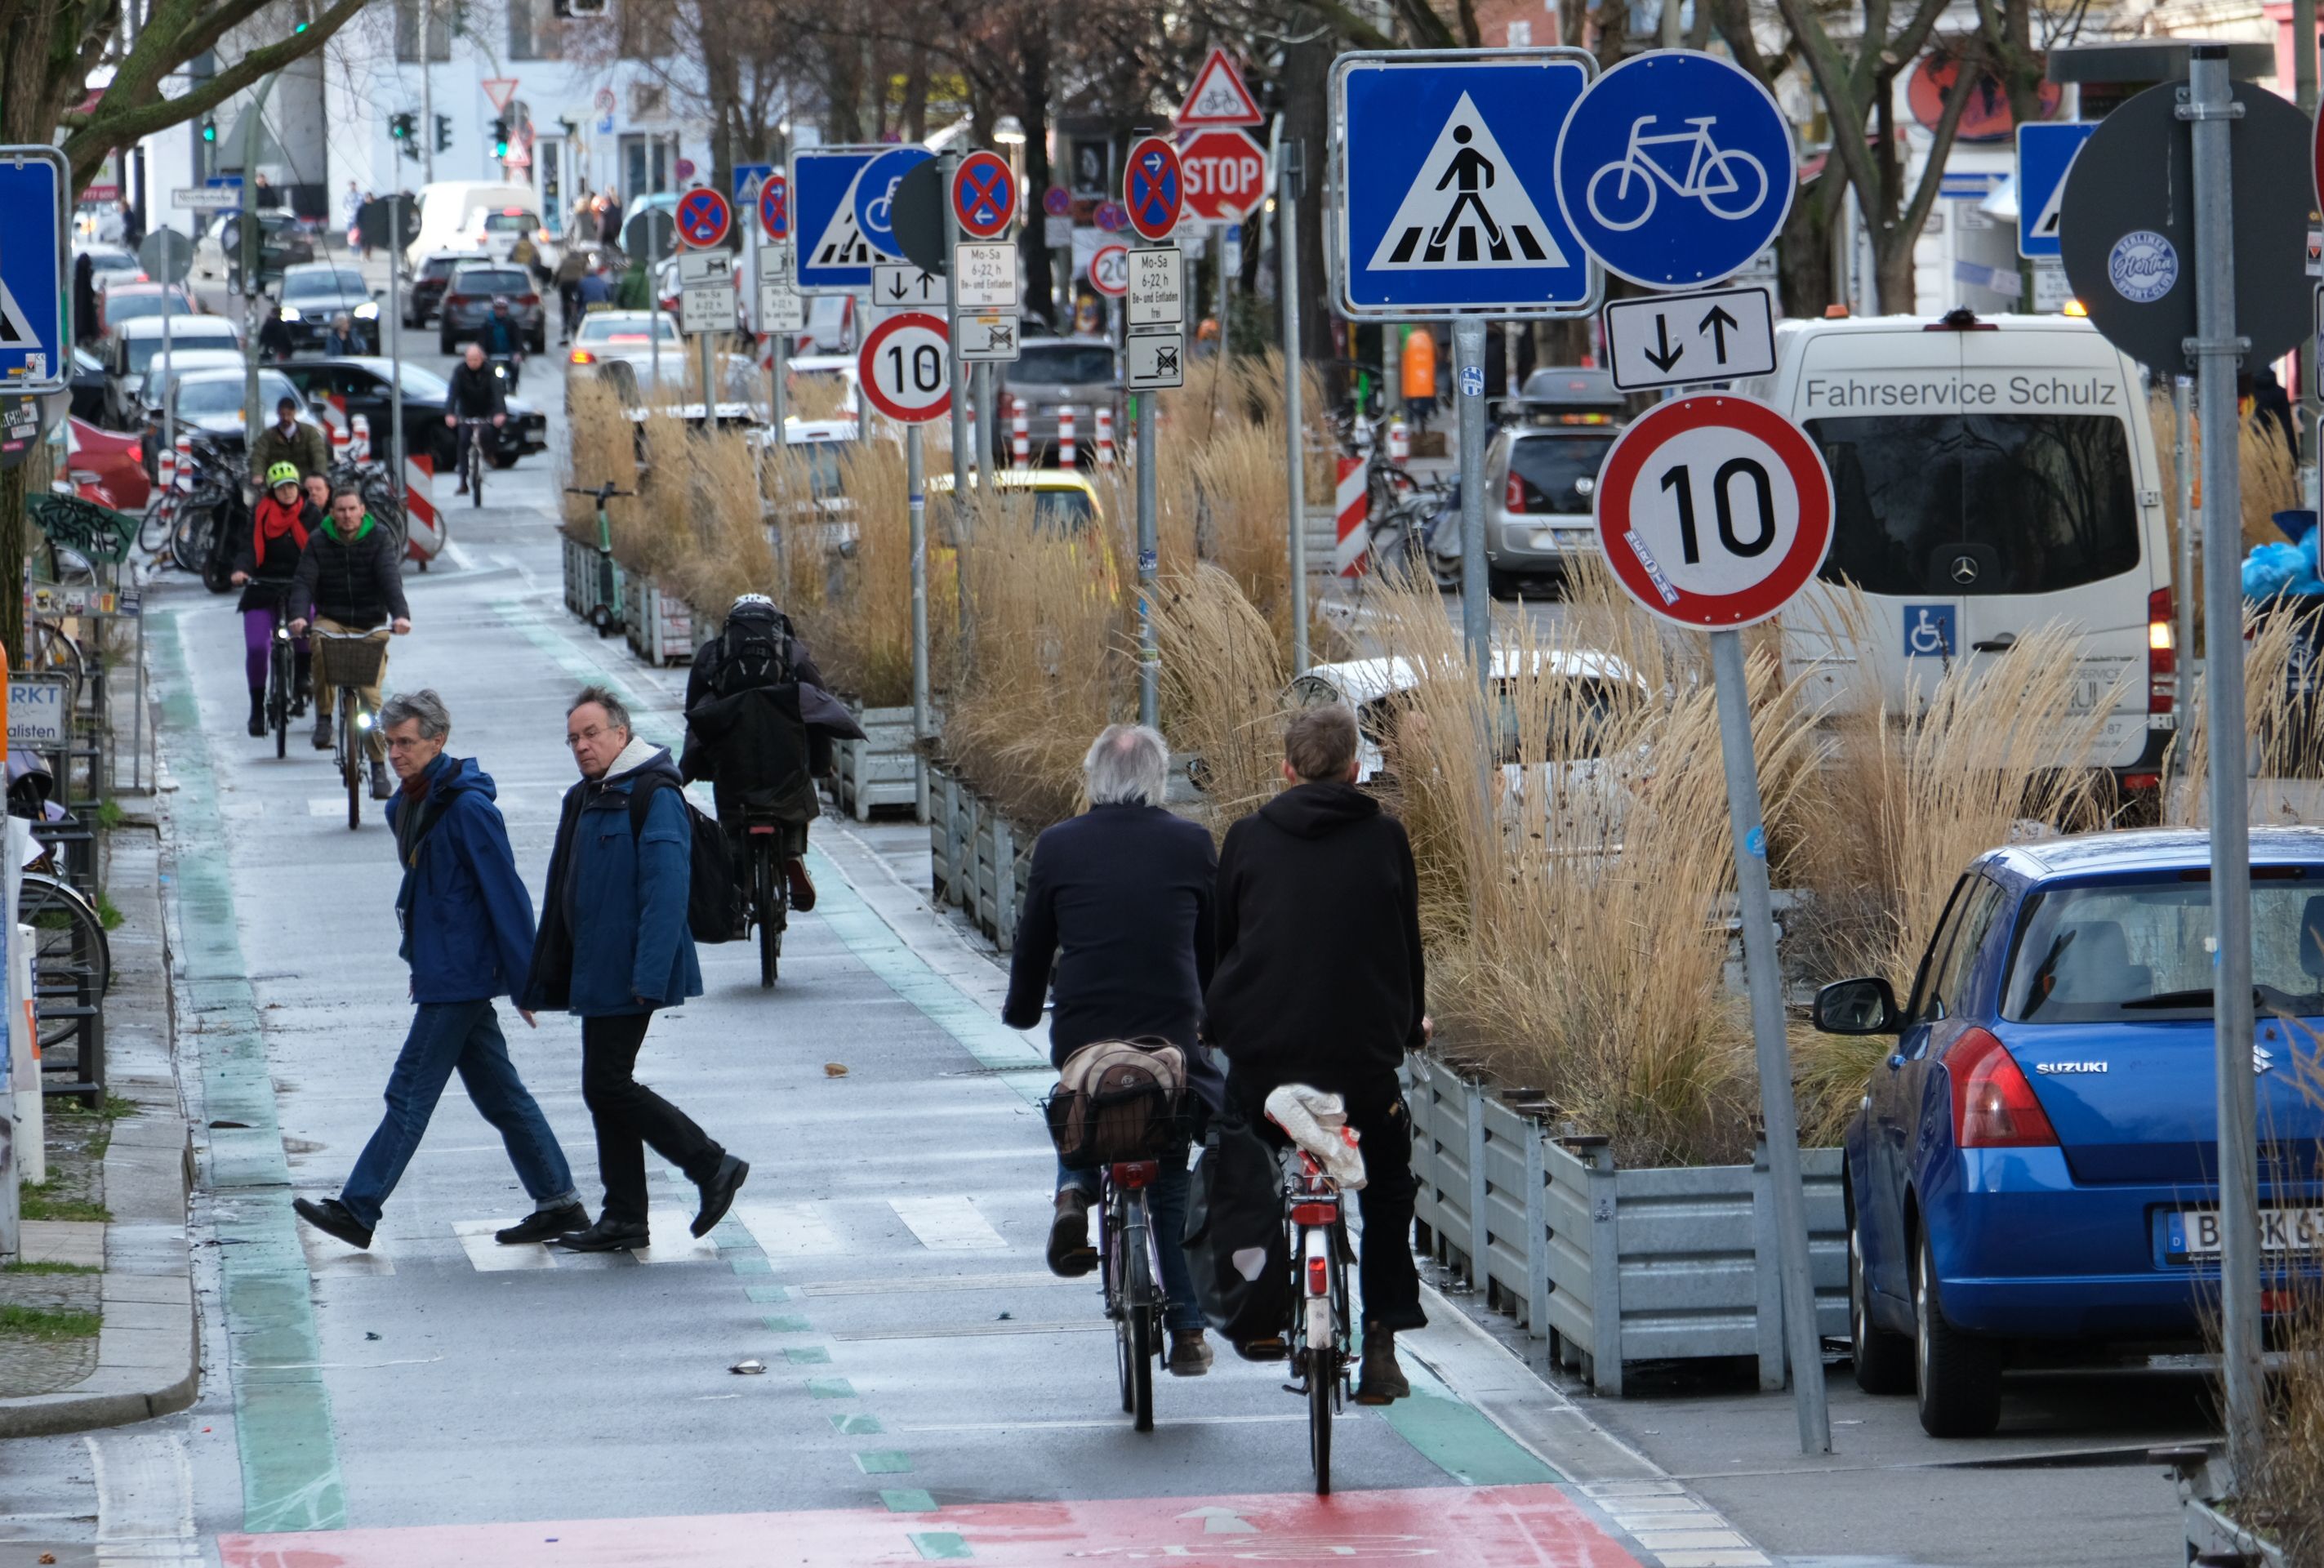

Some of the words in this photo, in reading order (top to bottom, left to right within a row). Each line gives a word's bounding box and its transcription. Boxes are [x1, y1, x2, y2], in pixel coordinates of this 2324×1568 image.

[1184, 157, 1259, 194] STOP
[971, 248, 1001, 260] Mo-Sa
[1142, 255, 1168, 269] Mo-Sa
[995, 265, 1001, 274] h
[1163, 273, 1169, 287] h
[1144, 292, 1154, 303] und
[1155, 291, 1178, 303] Entladen
[888, 344, 941, 394] 10
[1806, 376, 1997, 408] Fahrservice
[2008, 376, 2117, 406] Schulz
[1660, 457, 1776, 565] 10
[2107, 724, 2122, 734] 87
[2036, 1061, 2108, 1075] SUZUKI
[2172, 1236, 2181, 1247] D
